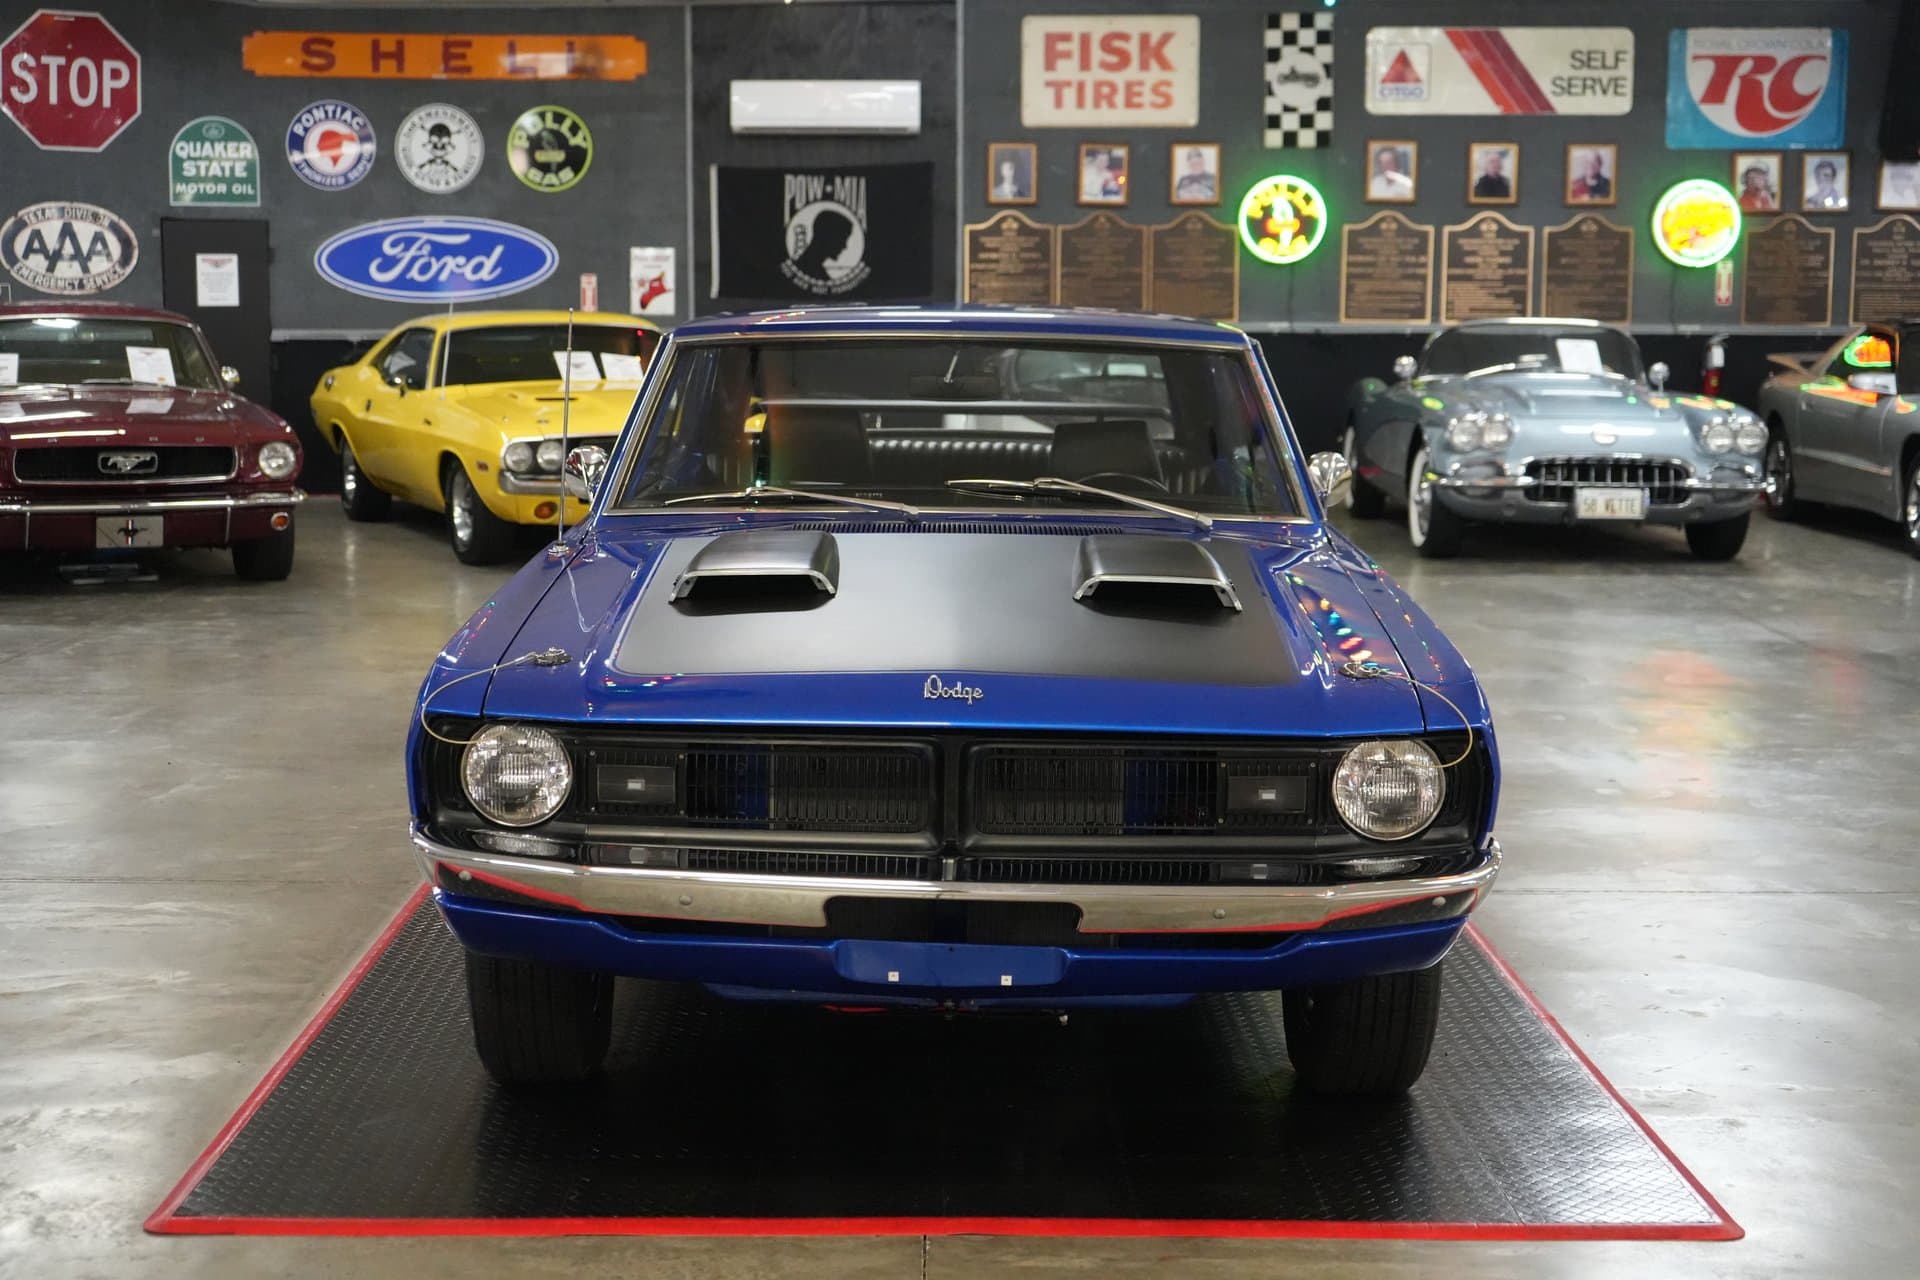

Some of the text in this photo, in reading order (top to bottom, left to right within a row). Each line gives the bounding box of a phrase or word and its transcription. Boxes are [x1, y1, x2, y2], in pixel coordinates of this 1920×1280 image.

[301, 36, 598, 76] SHELL
[1043, 31, 1177, 72] FISK
[1570, 50, 1628, 70] SELF
[9, 52, 131, 109] STOP
[1044, 79, 1175, 110] TIRES
[1379, 86, 1425, 99] CITGO
[1552, 76, 1628, 97] SERVE
[1691, 53, 1828, 132] RC
[292, 105, 365, 137] PONTIAC
[512, 111, 588, 150] POLLY
[175, 140, 253, 160] QUAKER
[182, 159, 249, 178] STATE
[526, 165, 575, 187] GAS
[176, 182, 255, 196] MOTOR OIL
[22, 221, 115, 274] AAA
[369, 231, 505, 283] Ford
[924, 674, 984, 705] Dodge
